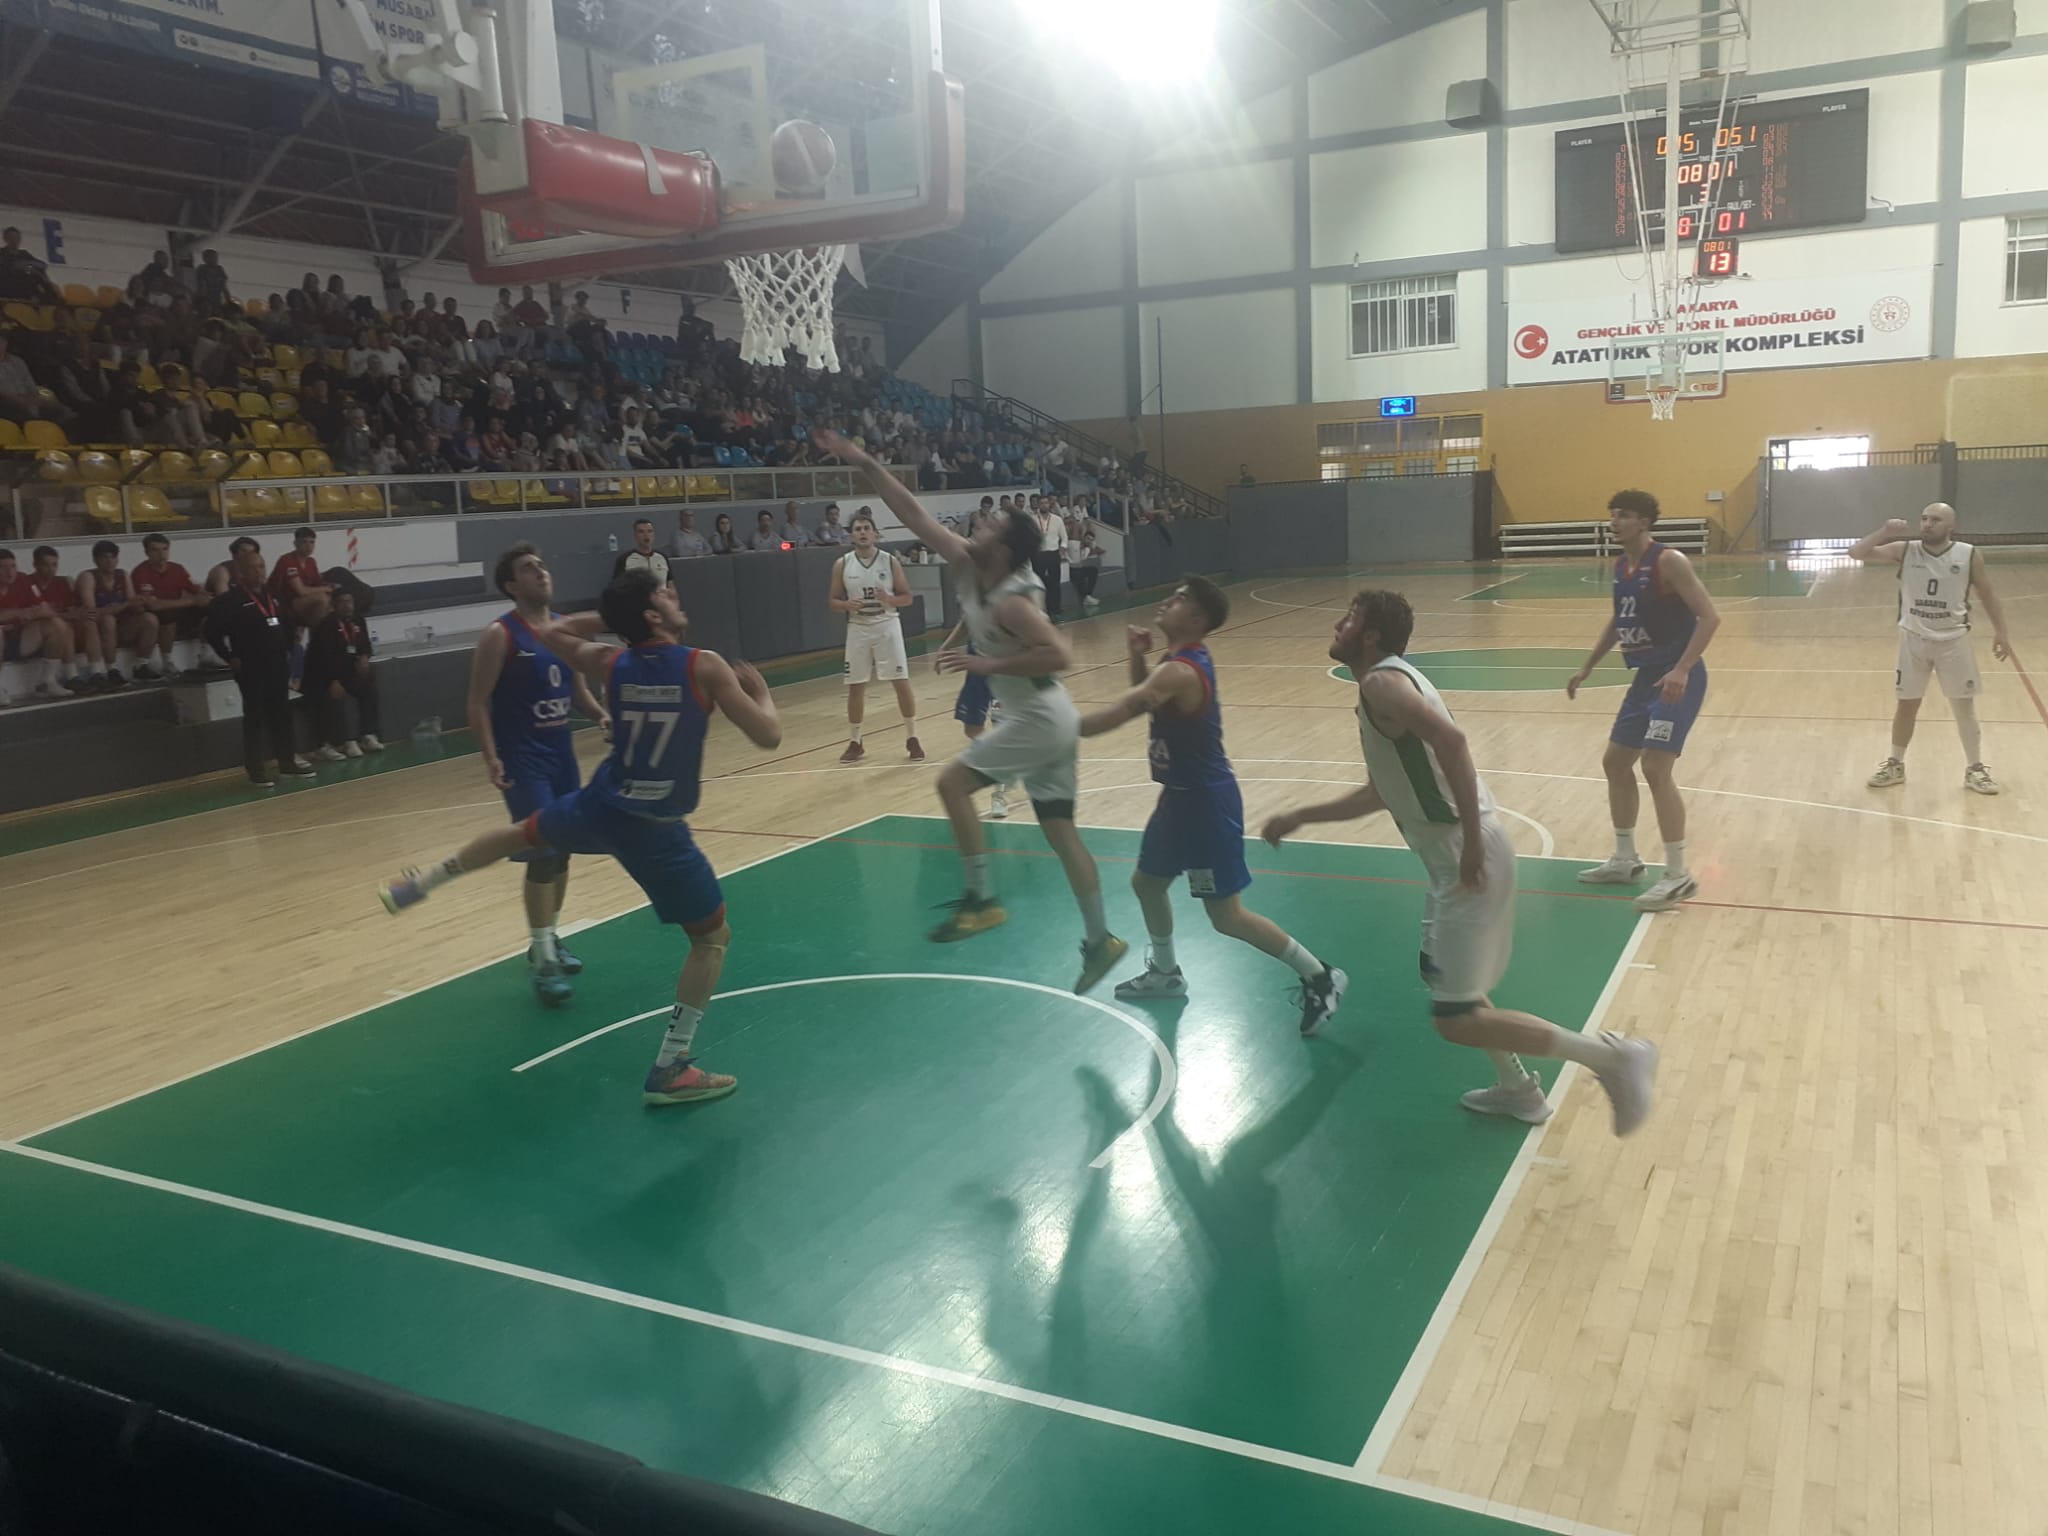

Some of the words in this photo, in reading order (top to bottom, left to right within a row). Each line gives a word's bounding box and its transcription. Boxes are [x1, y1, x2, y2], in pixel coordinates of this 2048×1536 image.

[1718, 211, 1745, 232] 01
[43, 218, 66, 265] E
[1709, 252, 1731, 272] 13
[1677, 300, 1739, 314] AKARYA
[1577, 323, 1642, 339] GENÇLİK
[1645, 321, 1665, 334] VE
[1715, 317, 1730, 329] İL
[1733, 307, 1836, 328] MÜDÜRLÜĞÜ
[1725, 325, 1865, 353] KOMPLEKSİ
[862, 586, 876, 600] 12
[1926, 578, 1938, 596] 0
[1619, 595, 1637, 618] 22
[548, 664, 562, 688] 0
[621, 710, 681, 769] 77
